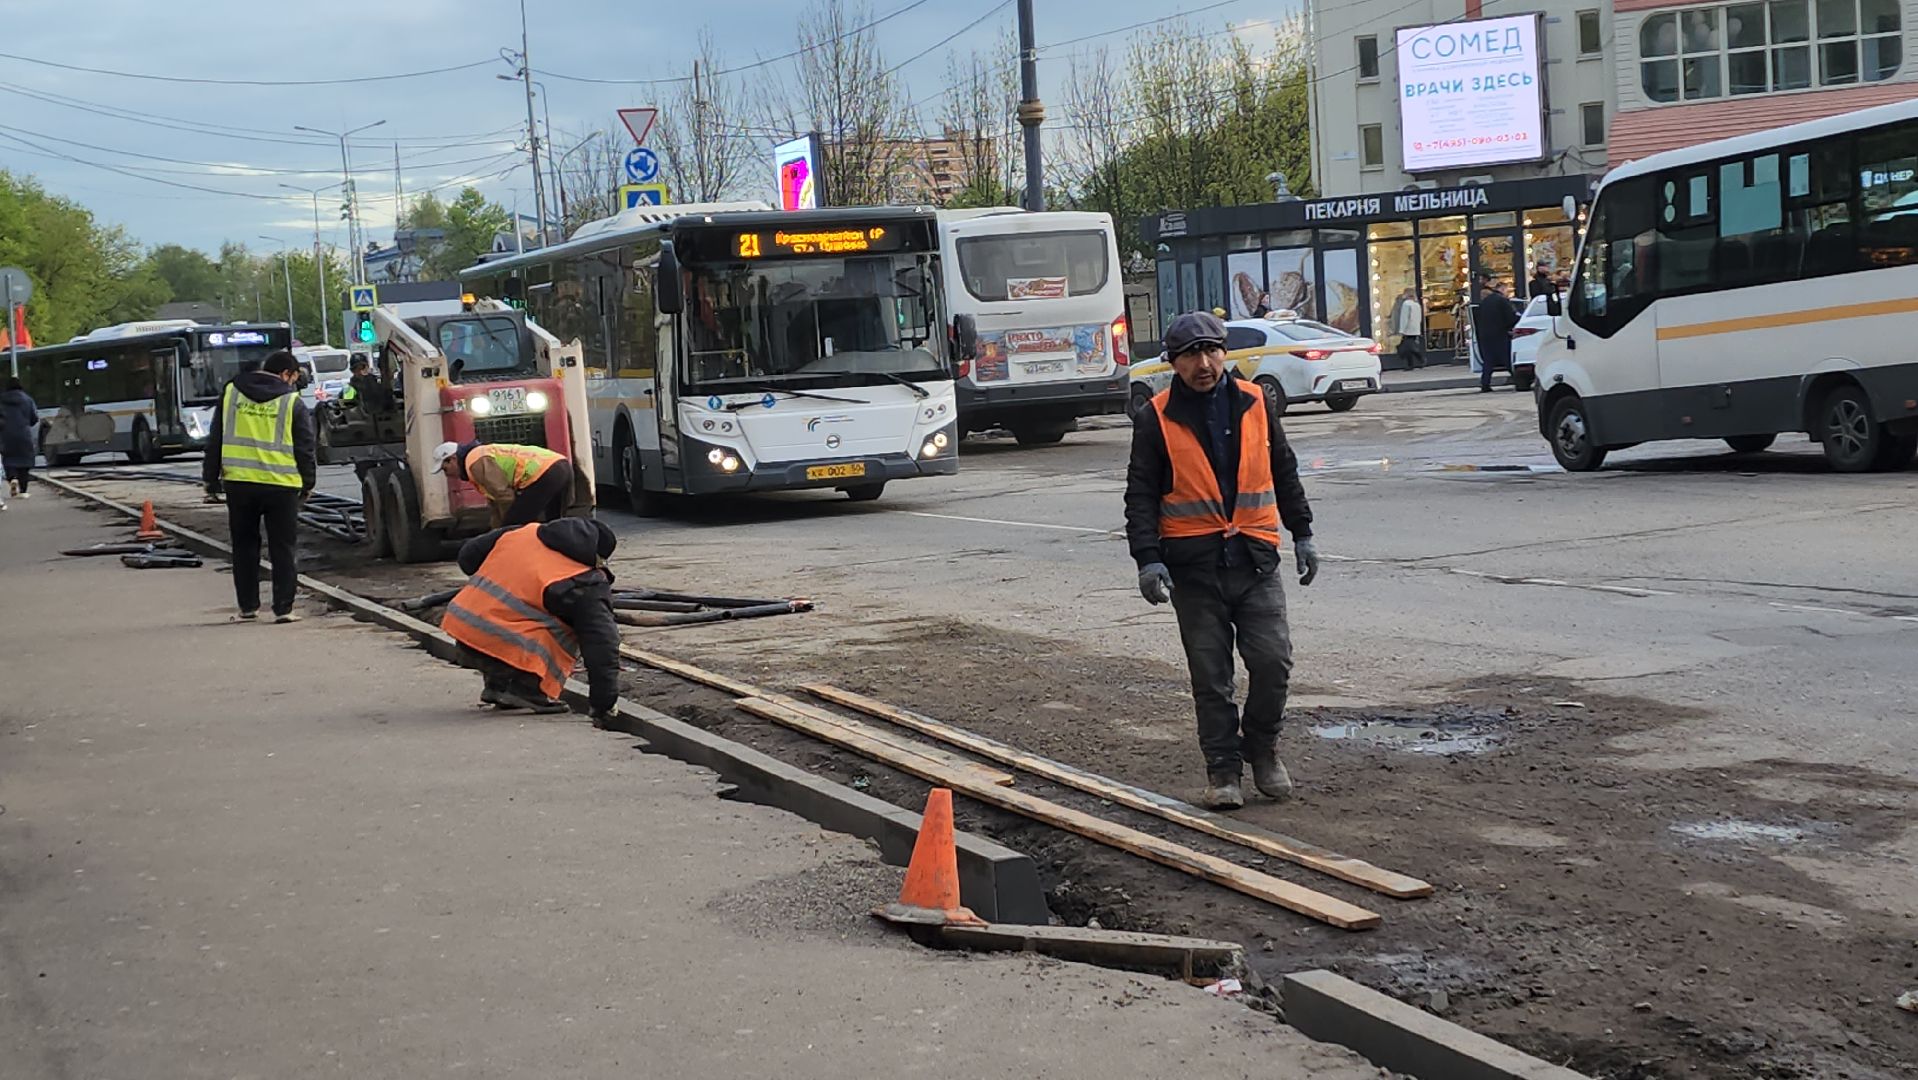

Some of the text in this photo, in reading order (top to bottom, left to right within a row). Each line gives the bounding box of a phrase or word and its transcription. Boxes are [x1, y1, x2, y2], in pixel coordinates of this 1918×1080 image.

[1412, 27, 1522, 59] СОМЕД
[1405, 72, 1533, 97] ВРАЧИ ЗДЕСЬ
[1304, 187, 1488, 220] ПЕКАРНЯ МЕЛЬНИЦА
[739, 233, 761, 257] 21
